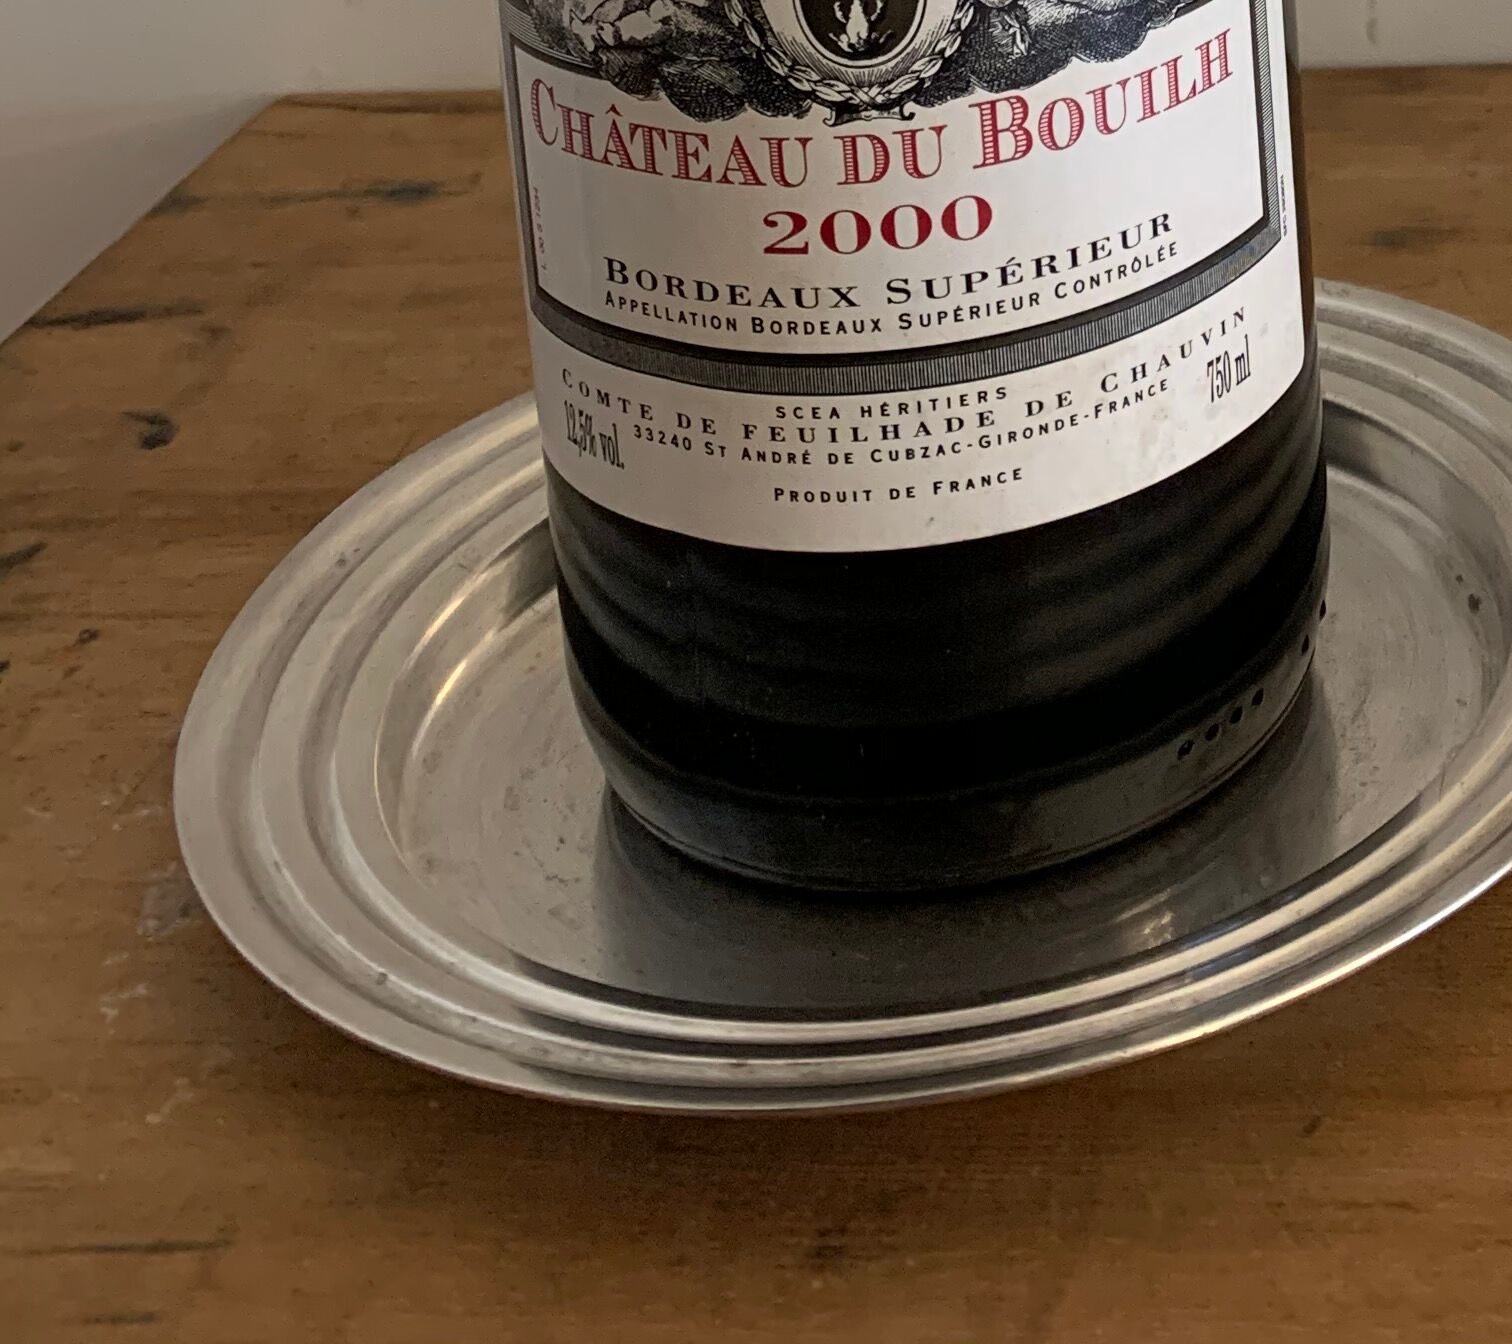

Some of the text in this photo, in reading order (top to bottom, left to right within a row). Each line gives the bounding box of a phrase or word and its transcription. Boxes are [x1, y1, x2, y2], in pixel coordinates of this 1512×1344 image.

[530, 28, 1234, 188] CHÂTEAU DU BOUILH
[762, 195, 993, 255] 2000
[603, 212, 1173, 309] BORDEAUX SUPÉRIEUR
[605, 241, 1178, 337] APPELLATION BORDEAUX SUPÉRIEUR CONTRÔLÉE
[562, 306, 1246, 444] COMTE DE FEUILHADE DE CHAUVIN
[775, 386, 1008, 420] SCEA HÉRITIERS
[1206, 333, 1251, 404] 750 ml
[564, 400, 625, 470] 12,5% vol.
[633, 424, 692, 451] 33240
[741, 447, 812, 465] ANDRÉ
[828, 451, 854, 465] DE
[774, 468, 1023, 504] PRODUIT DE FRANCE
